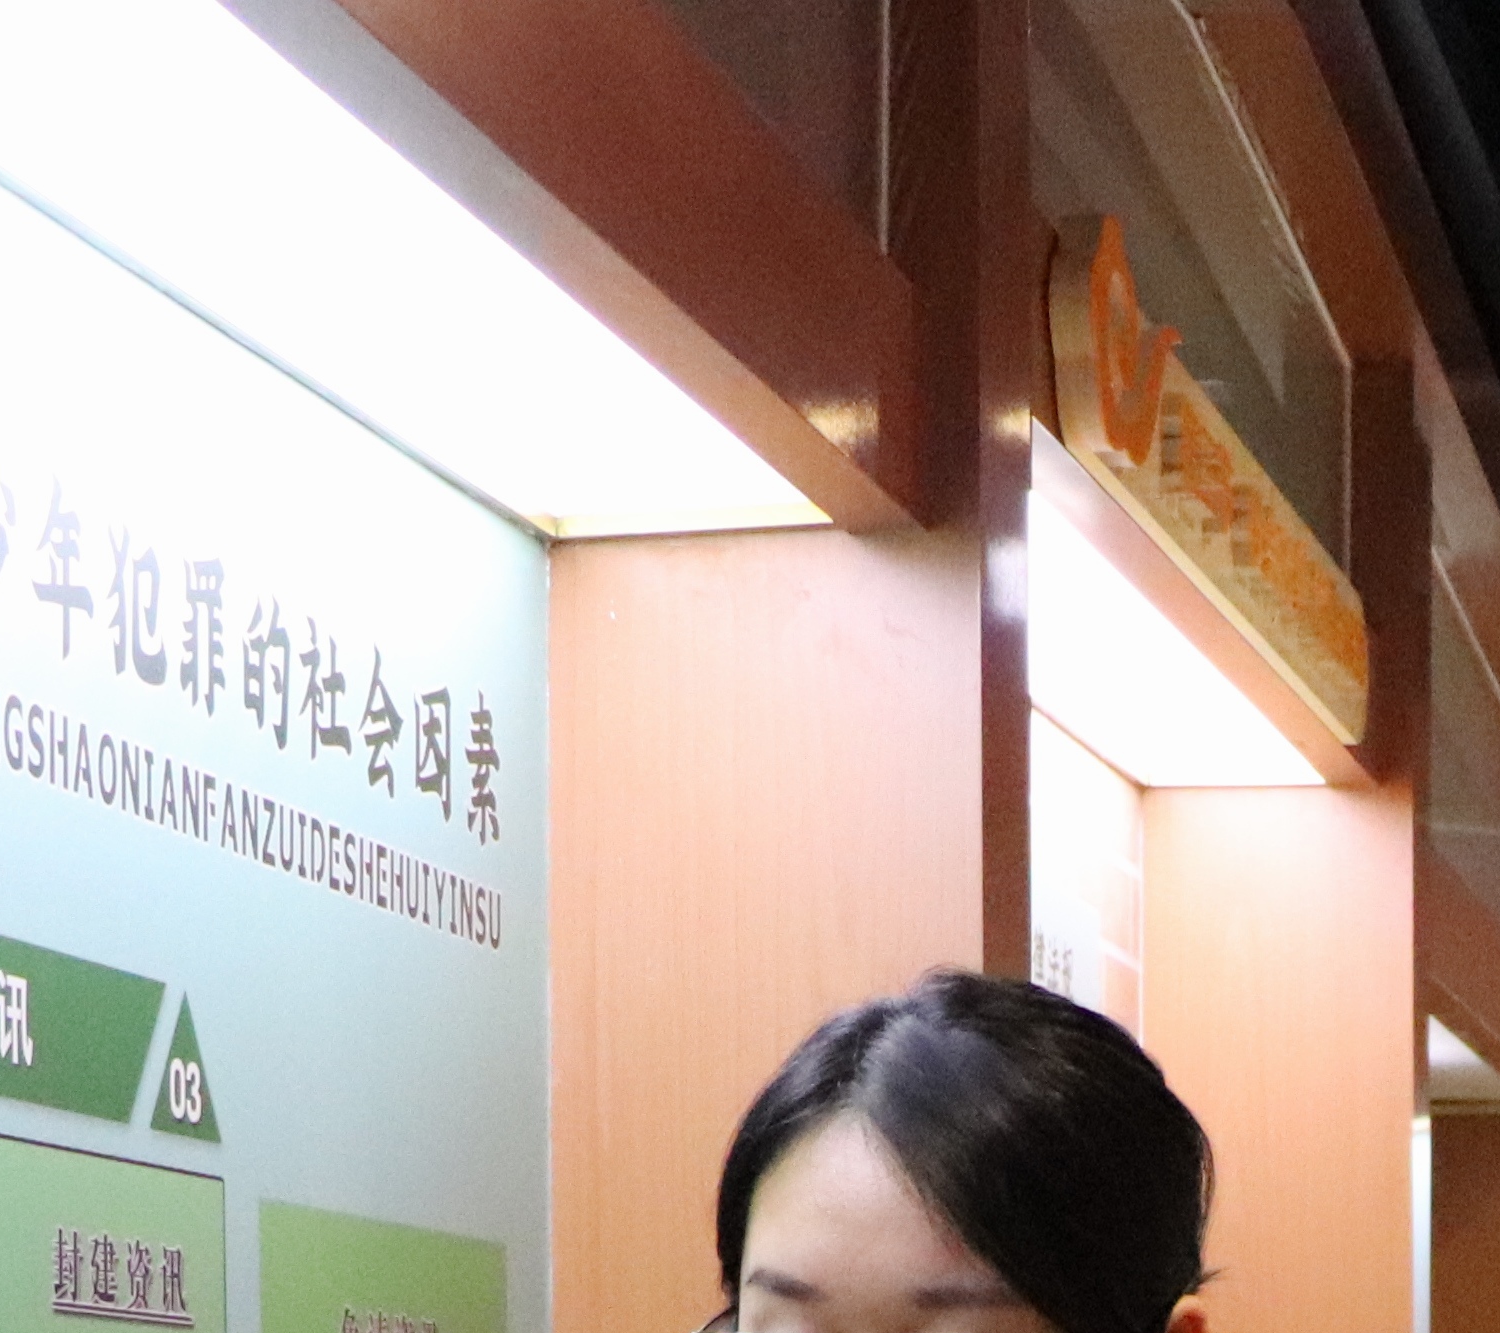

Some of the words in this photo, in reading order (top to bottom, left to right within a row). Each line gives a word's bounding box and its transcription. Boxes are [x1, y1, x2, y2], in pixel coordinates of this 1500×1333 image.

[168, 1056, 203, 1125] 03
[54, 1228, 187, 1312] 封建资讯
